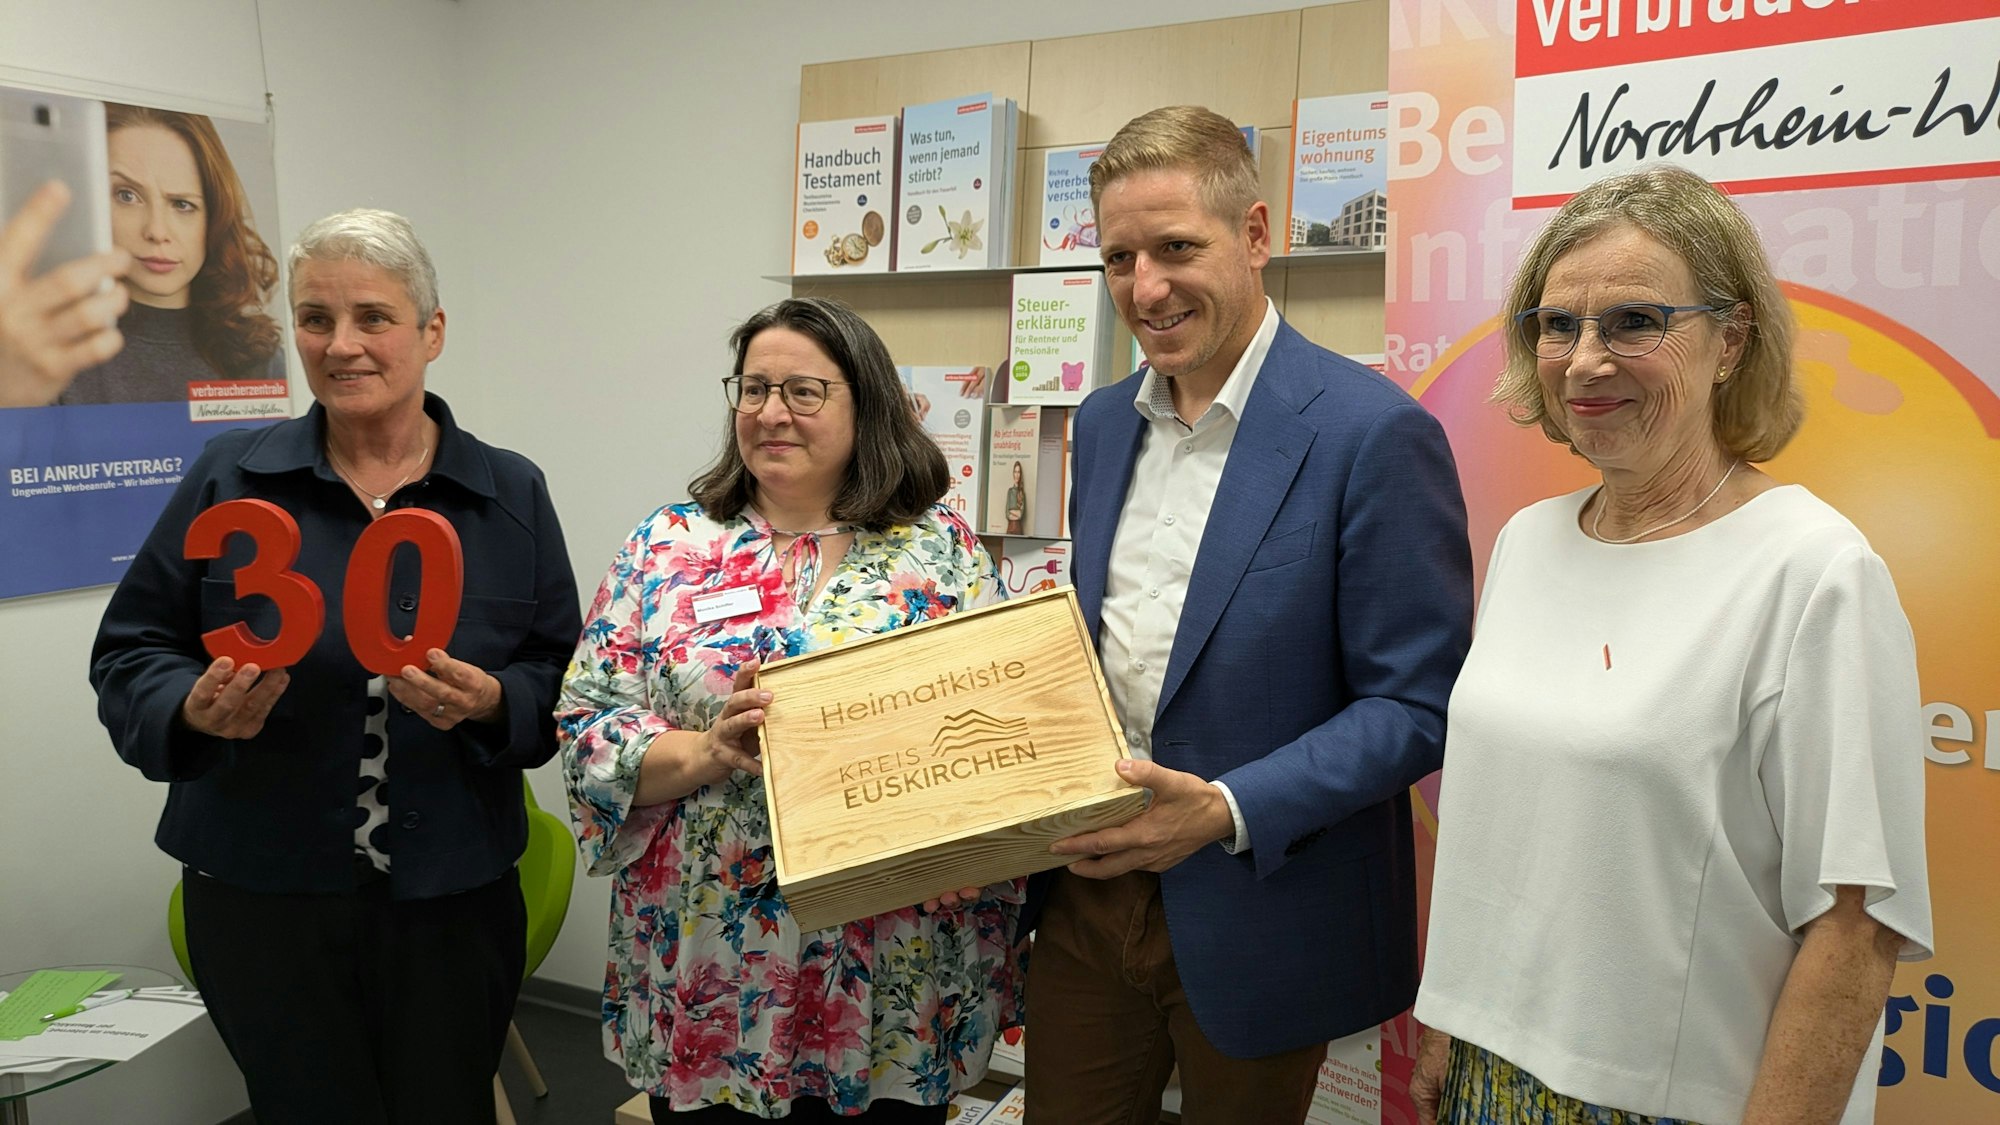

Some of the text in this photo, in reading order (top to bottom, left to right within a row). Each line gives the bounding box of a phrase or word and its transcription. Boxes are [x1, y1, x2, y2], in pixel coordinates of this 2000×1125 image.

[1548, 60, 2000, 170] Nordrhein-W
[910, 129, 955, 146] Was tun,
[1302, 127, 1387, 148] Eigentums
[804, 147, 881, 169] Handbuch
[909, 141, 980, 164] wenn jemand
[1300, 148, 1375, 164] wohnung
[802, 170, 882, 189] Testament
[908, 167, 943, 184] stirbt?
[1017, 298, 1070, 312] Steuer-
[1016, 315, 1086, 332] erklärung
[1015, 334, 1078, 344] für Rentner und
[1014, 346, 1060, 355] Pensionäre
[191, 382, 285, 397] verbraucherzentrale
[10, 457, 183, 485] BEI ANRUF VERTRAG?
[12, 486, 62, 498] Ungewollte
[63, 480, 116, 493] Werbeanrufe
[124, 478, 138, 487] Wir
[139, 476, 164, 486] helfen
[820, 659, 1027, 730] Heimatkiste
[840, 747, 921, 784] KREIS
[843, 740, 1038, 809] EUSKIRCHEN
